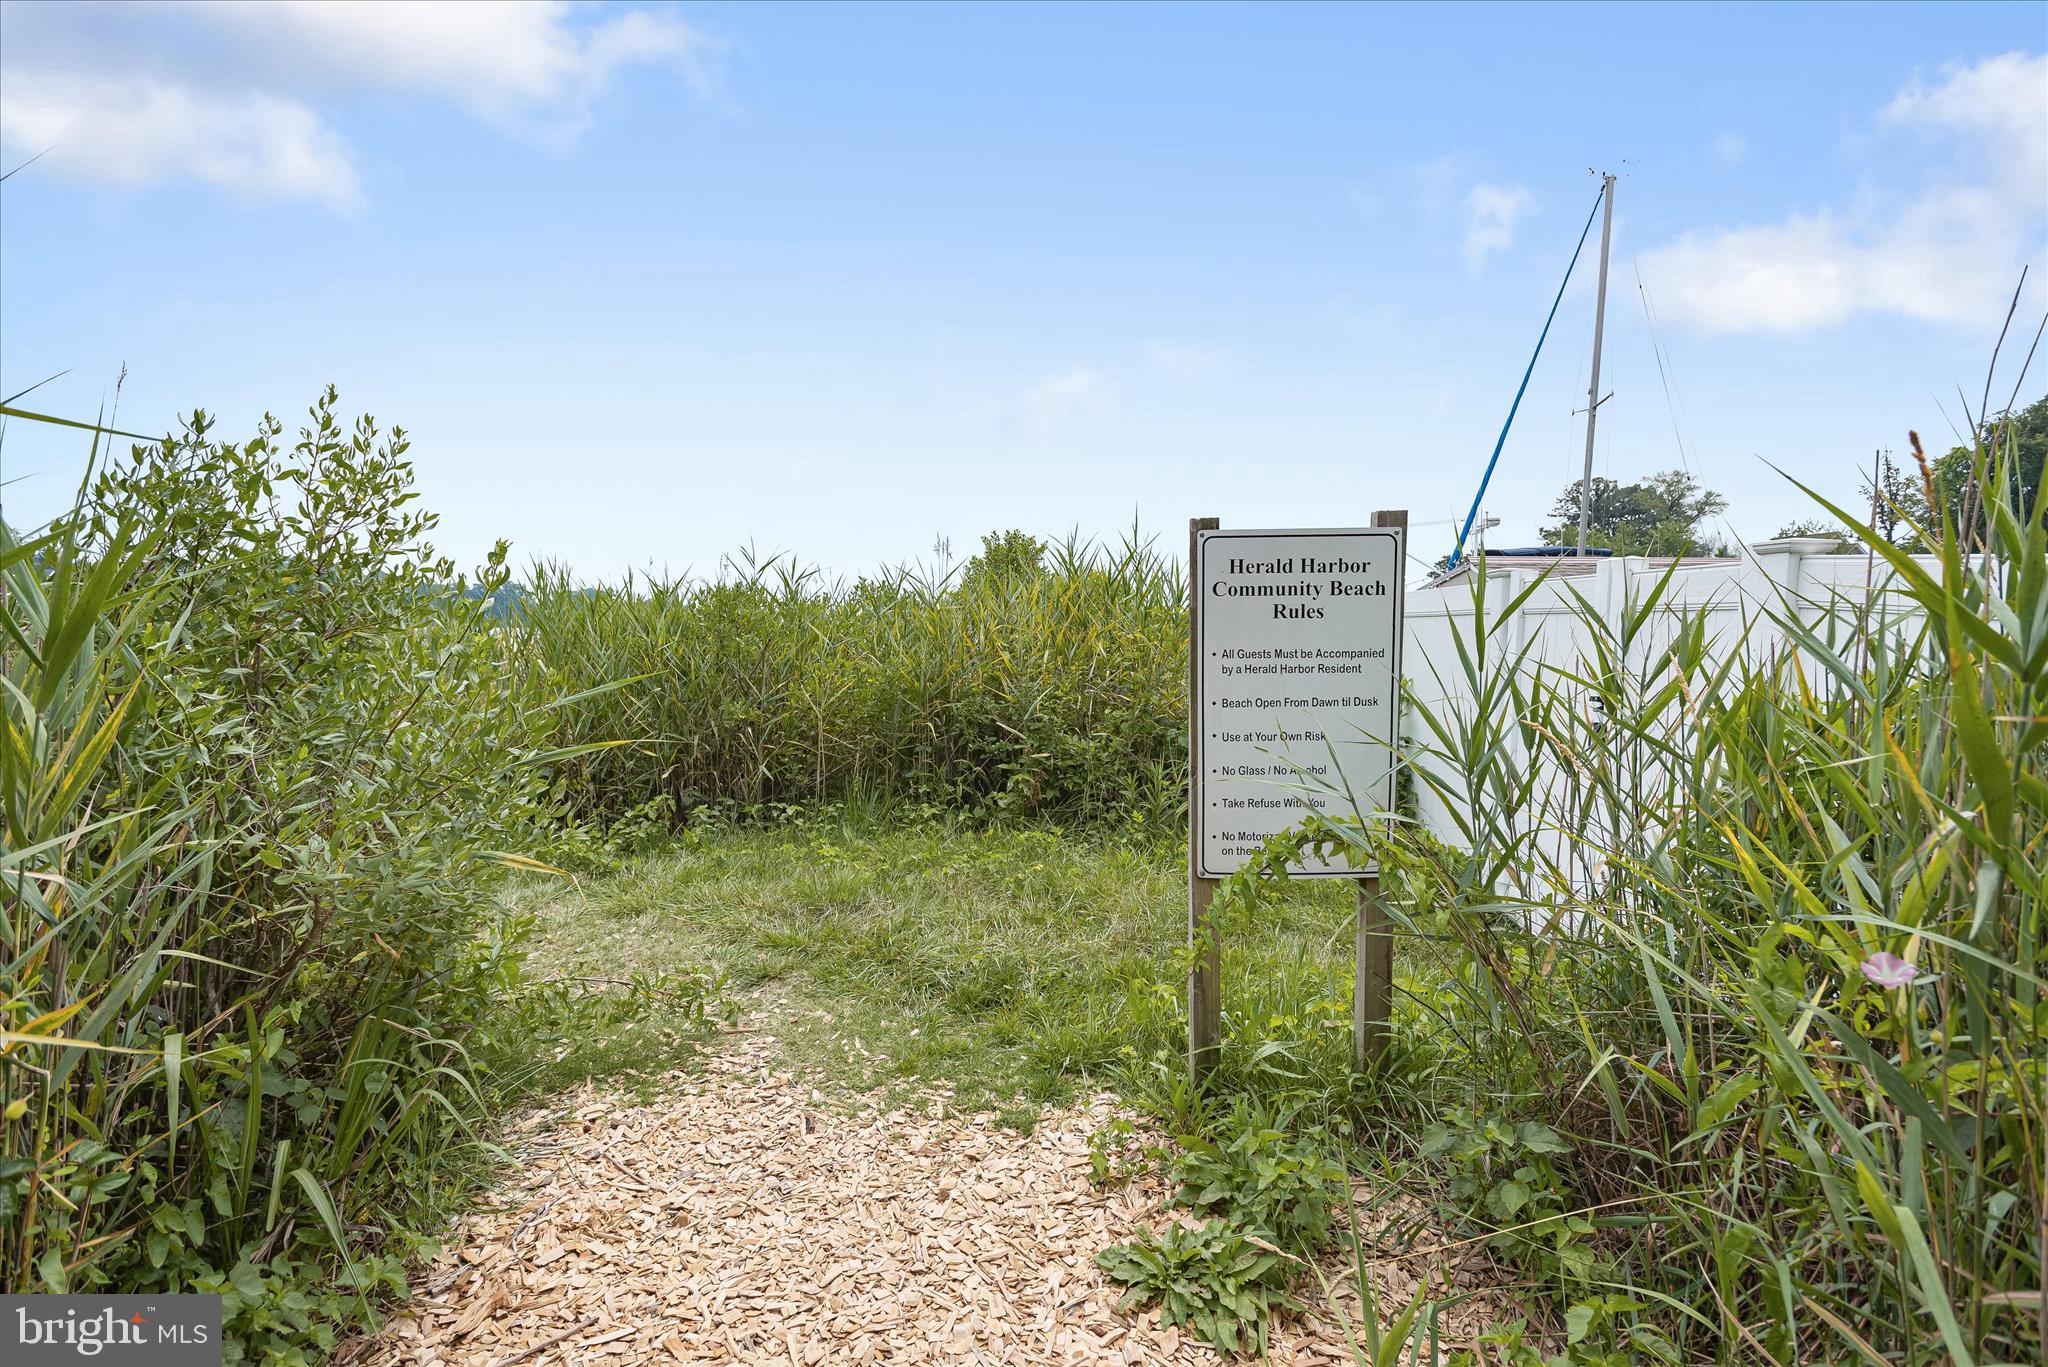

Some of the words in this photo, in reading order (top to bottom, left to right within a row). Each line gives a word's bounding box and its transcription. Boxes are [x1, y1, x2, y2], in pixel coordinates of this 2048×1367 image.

[1230, 558, 1293, 574] Herald
[1300, 558, 1370, 574] Harbor
[1212, 580, 1322, 600] Community
[1330, 580, 1386, 596] Beach
[1273, 603, 1324, 619] Rules
[1222, 649, 1234, 659] All
[1237, 649, 1271, 659] Guests
[1274, 649, 1298, 659] Must
[1301, 648, 1313, 659] be
[1316, 648, 1384, 661] Accompanied
[1222, 664, 1233, 676] by
[1236, 666, 1242, 674] a
[1245, 664, 1277, 674] Herald
[1280, 664, 1315, 674] Harbor
[1318, 663, 1362, 674] Resident
[1222, 698, 1252, 708] Beach
[1255, 698, 1281, 710] Open
[1285, 697, 1309, 708] From
[1312, 697, 1339, 707] Dawn
[1342, 696, 1351, 707] til
[1354, 696, 1378, 707] Dusk
[1222, 732, 1240, 742] Use
[1244, 732, 1253, 742] at
[1255, 731, 1277, 742] Your
[1280, 731, 1302, 741] Own
[1305, 731, 1326, 741] Risk
[1222, 766, 1236, 776] No
[1239, 765, 1266, 776] Glass
[1268, 766, 1271, 775] /
[1274, 765, 1287, 775] No
[1222, 798, 1244, 808] Take
[1248, 798, 1280, 808] Refuse
[1283, 798, 1306, 808] Wit
[1309, 798, 1325, 808] You
[1222, 832, 1235, 841] No
[1222, 848, 1234, 856] on
[1237, 846, 1251, 856] the
